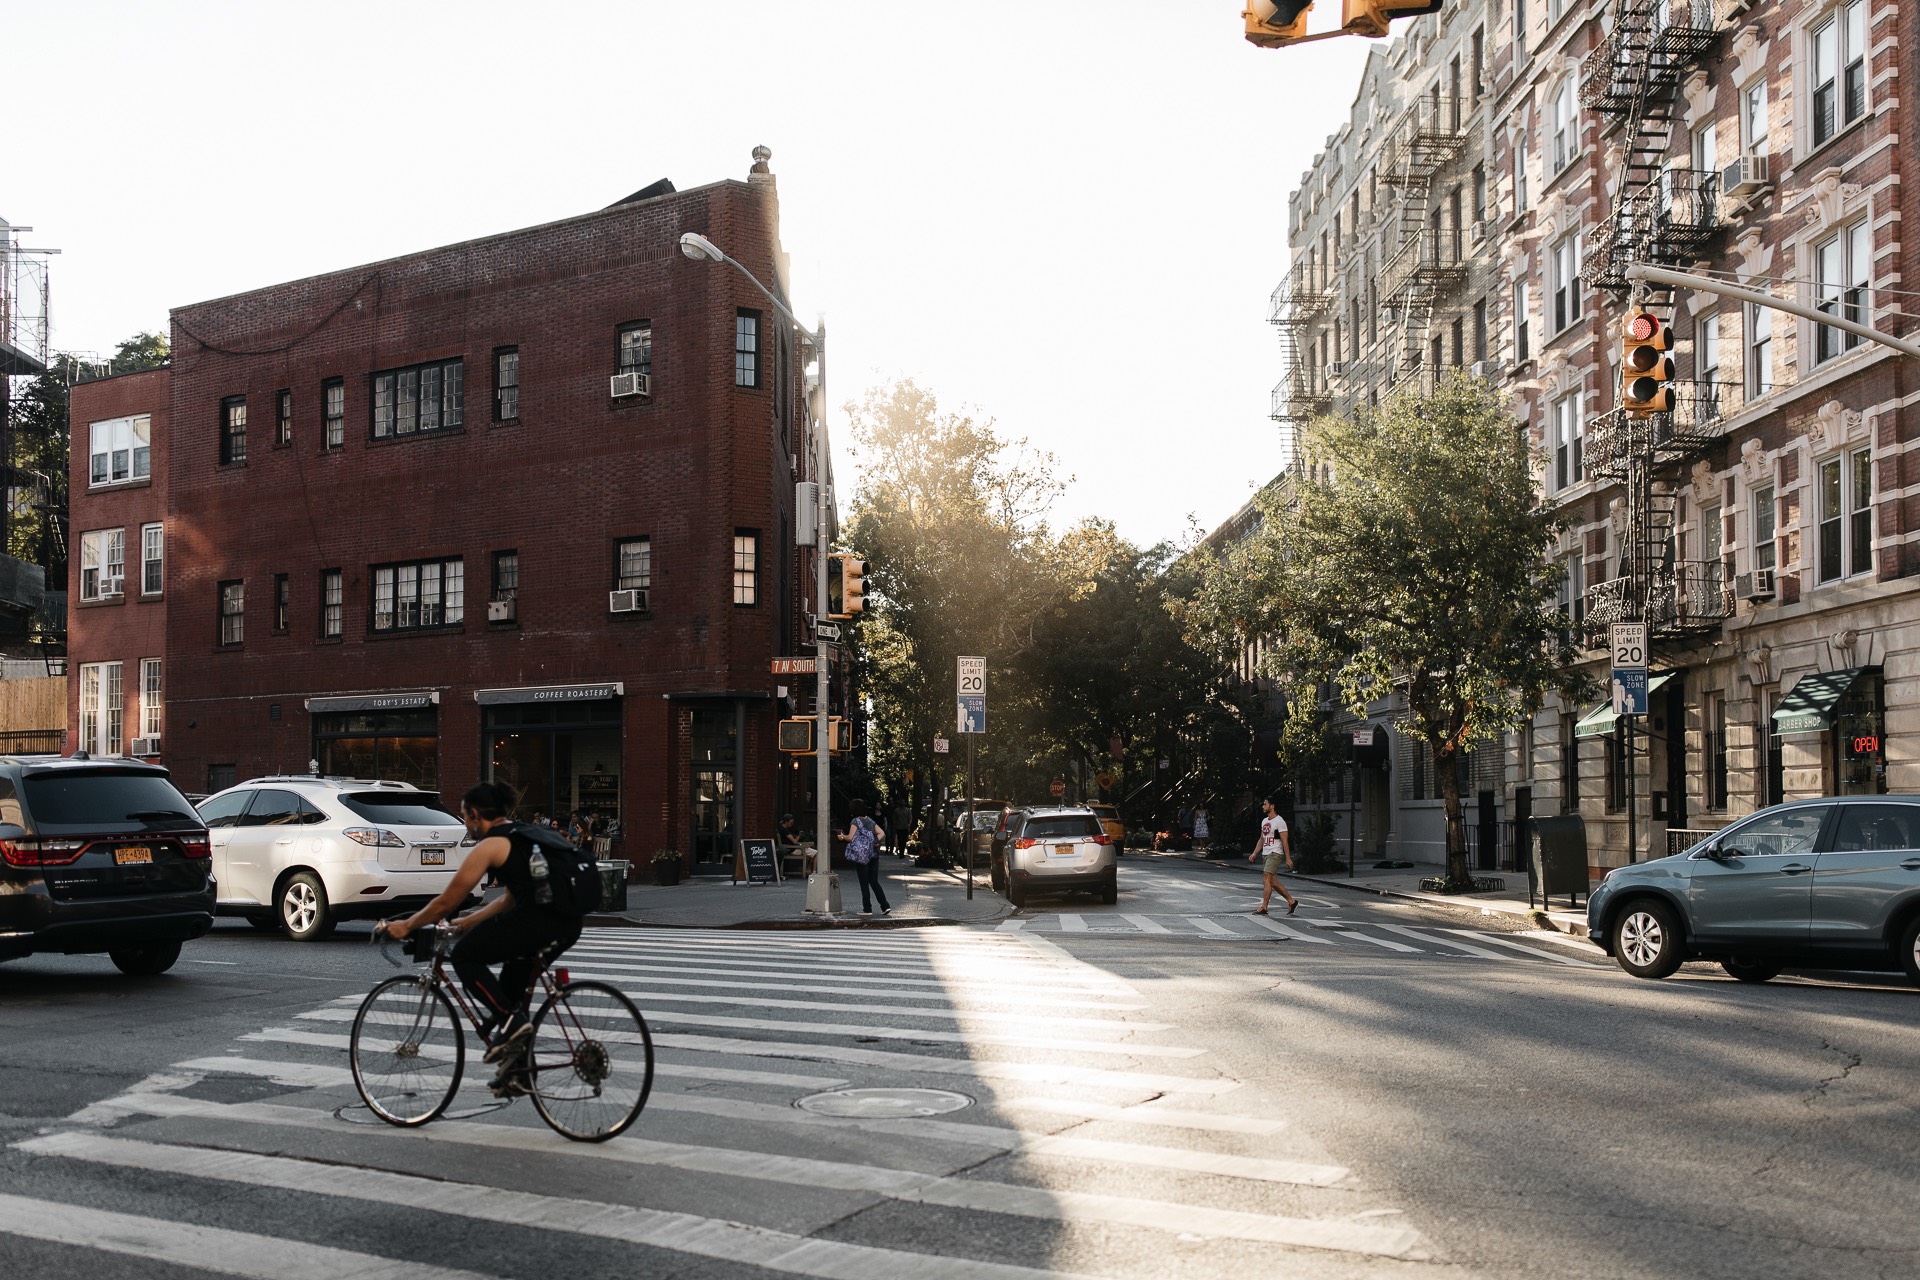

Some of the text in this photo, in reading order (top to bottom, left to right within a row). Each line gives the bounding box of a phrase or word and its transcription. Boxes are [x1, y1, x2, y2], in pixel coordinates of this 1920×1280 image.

[819, 626, 828, 636] ONE
[1618, 636, 1640, 644] LIMIT
[1617, 646, 1642, 662] 20
[774, 659, 814, 672] 7 AV SOUTH
[962, 676, 982, 690] 20
[567, 688, 608, 698] ROASTERS
[373, 699, 398, 707] TOBY'S
[1778, 716, 1822, 730] BARBER SHOP
[1854, 736, 1878, 752] OPEN
